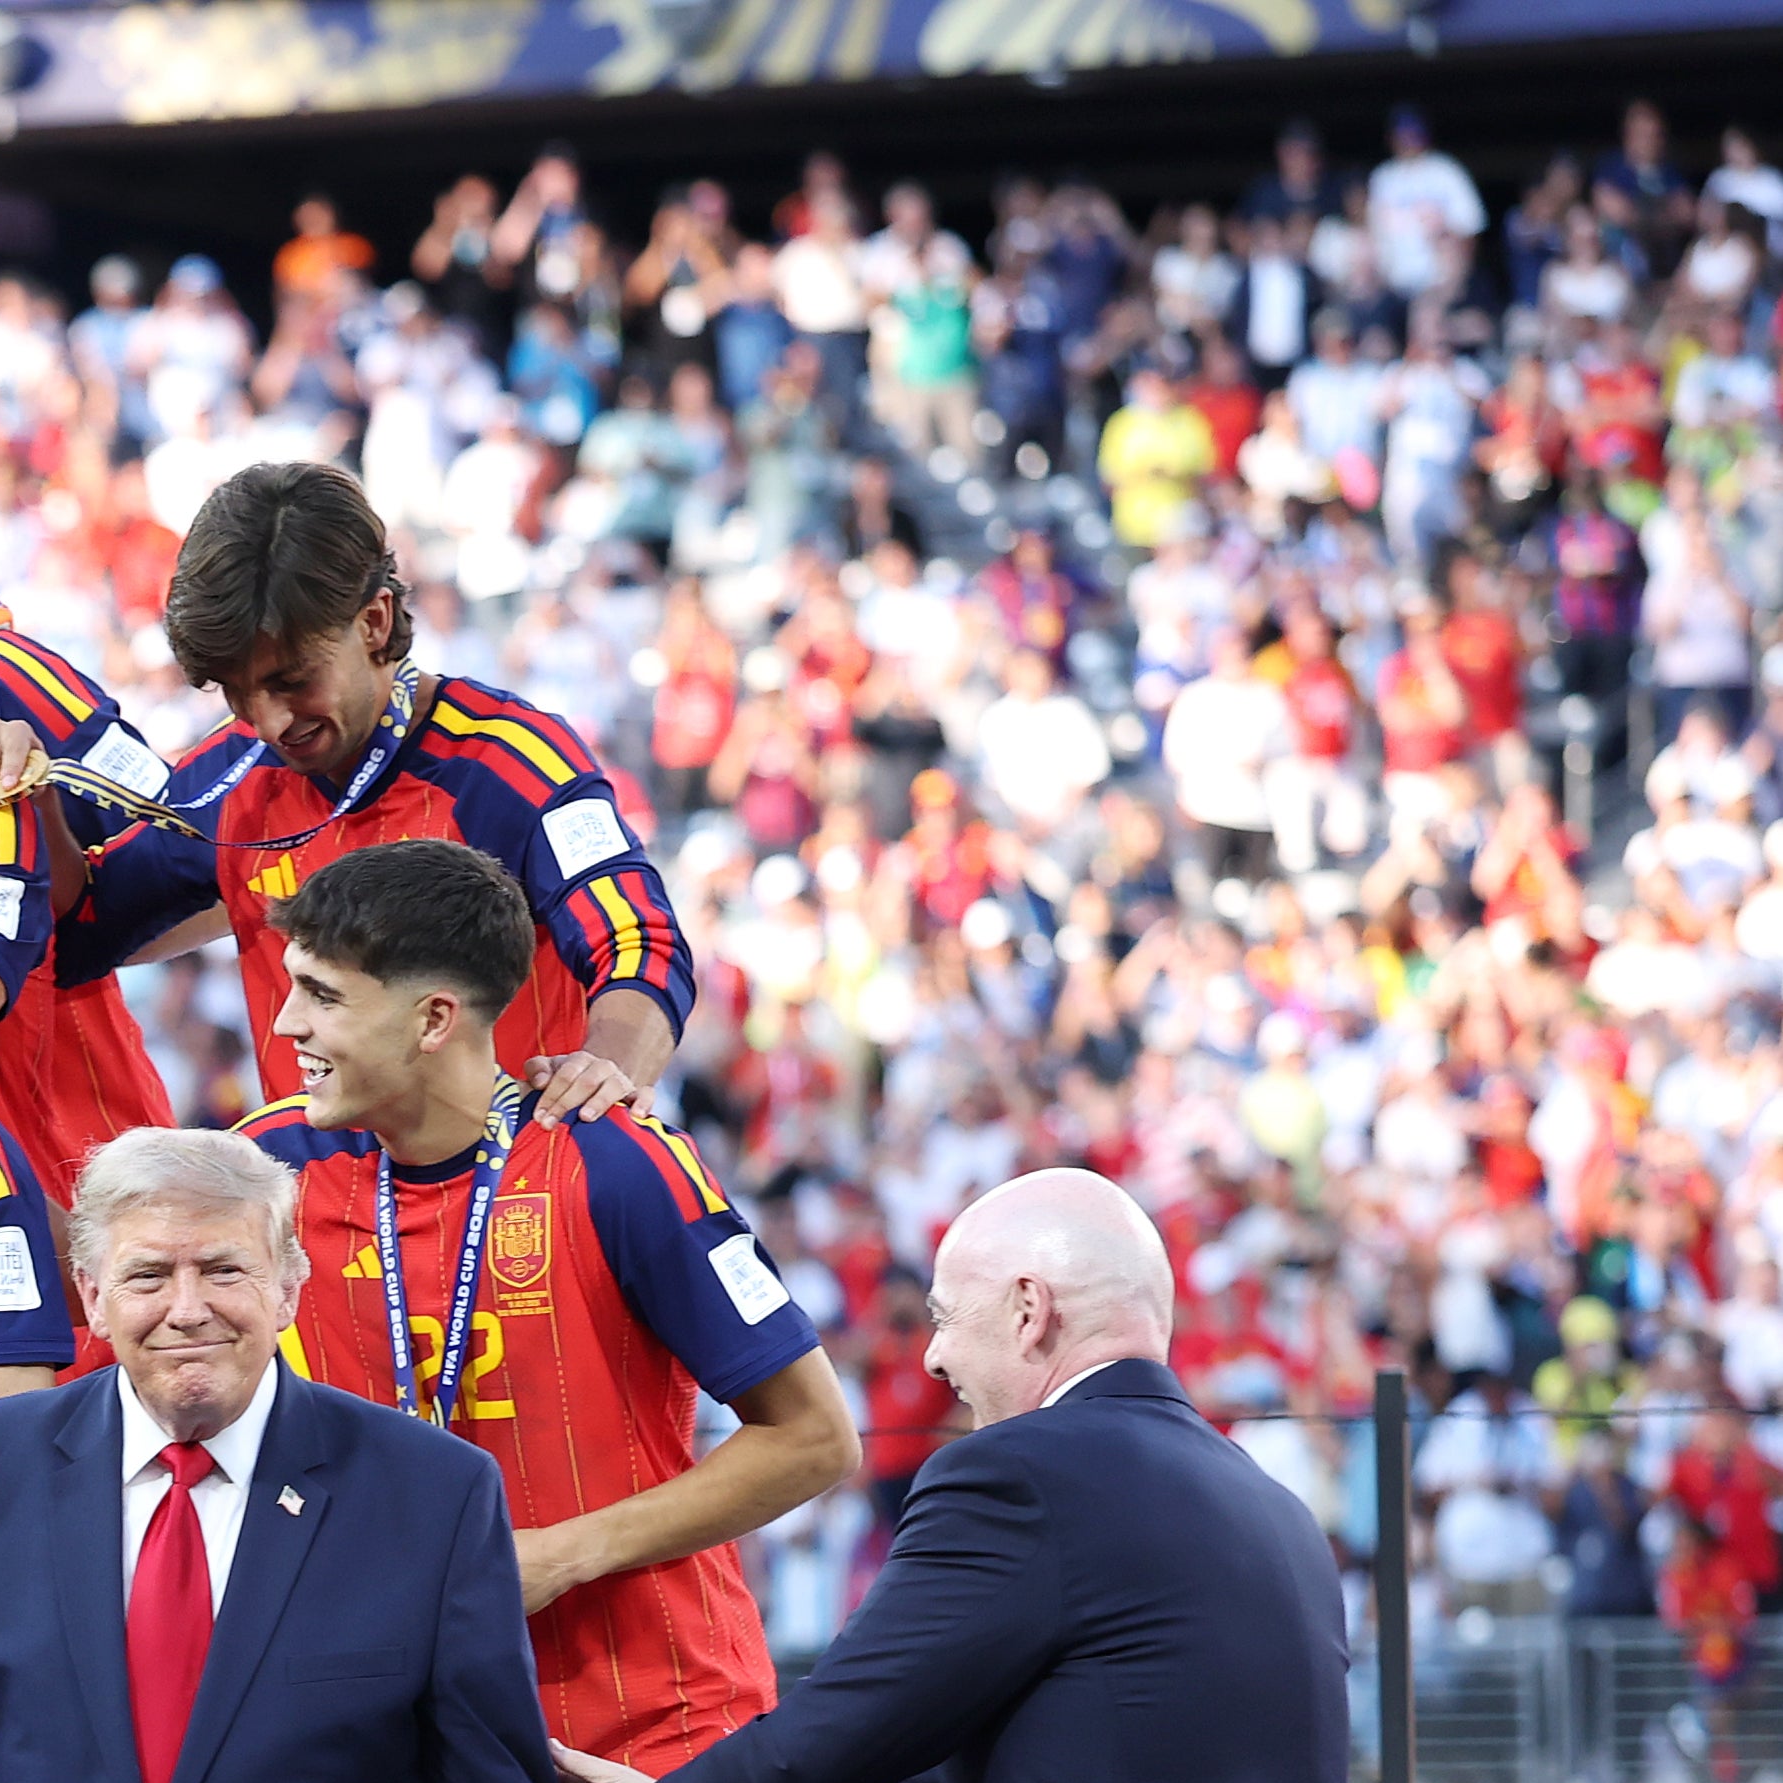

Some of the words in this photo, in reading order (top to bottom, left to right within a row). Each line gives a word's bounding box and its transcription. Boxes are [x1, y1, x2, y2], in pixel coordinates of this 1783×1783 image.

[227, 755, 255, 784] FIFA
[347, 748, 386, 800] 2026
[378, 1169, 390, 1208] FIFA
[379, 1208, 396, 1270] WORLD
[466, 1185, 491, 1248] 2026
[385, 1271, 401, 1307] CUP
[459, 1247, 476, 1284] CUP
[389, 1307, 409, 1369] 2026
[448, 1284, 472, 1347] WORLD
[407, 1311, 517, 1421] 22
[442, 1349, 460, 1386] FIFA
